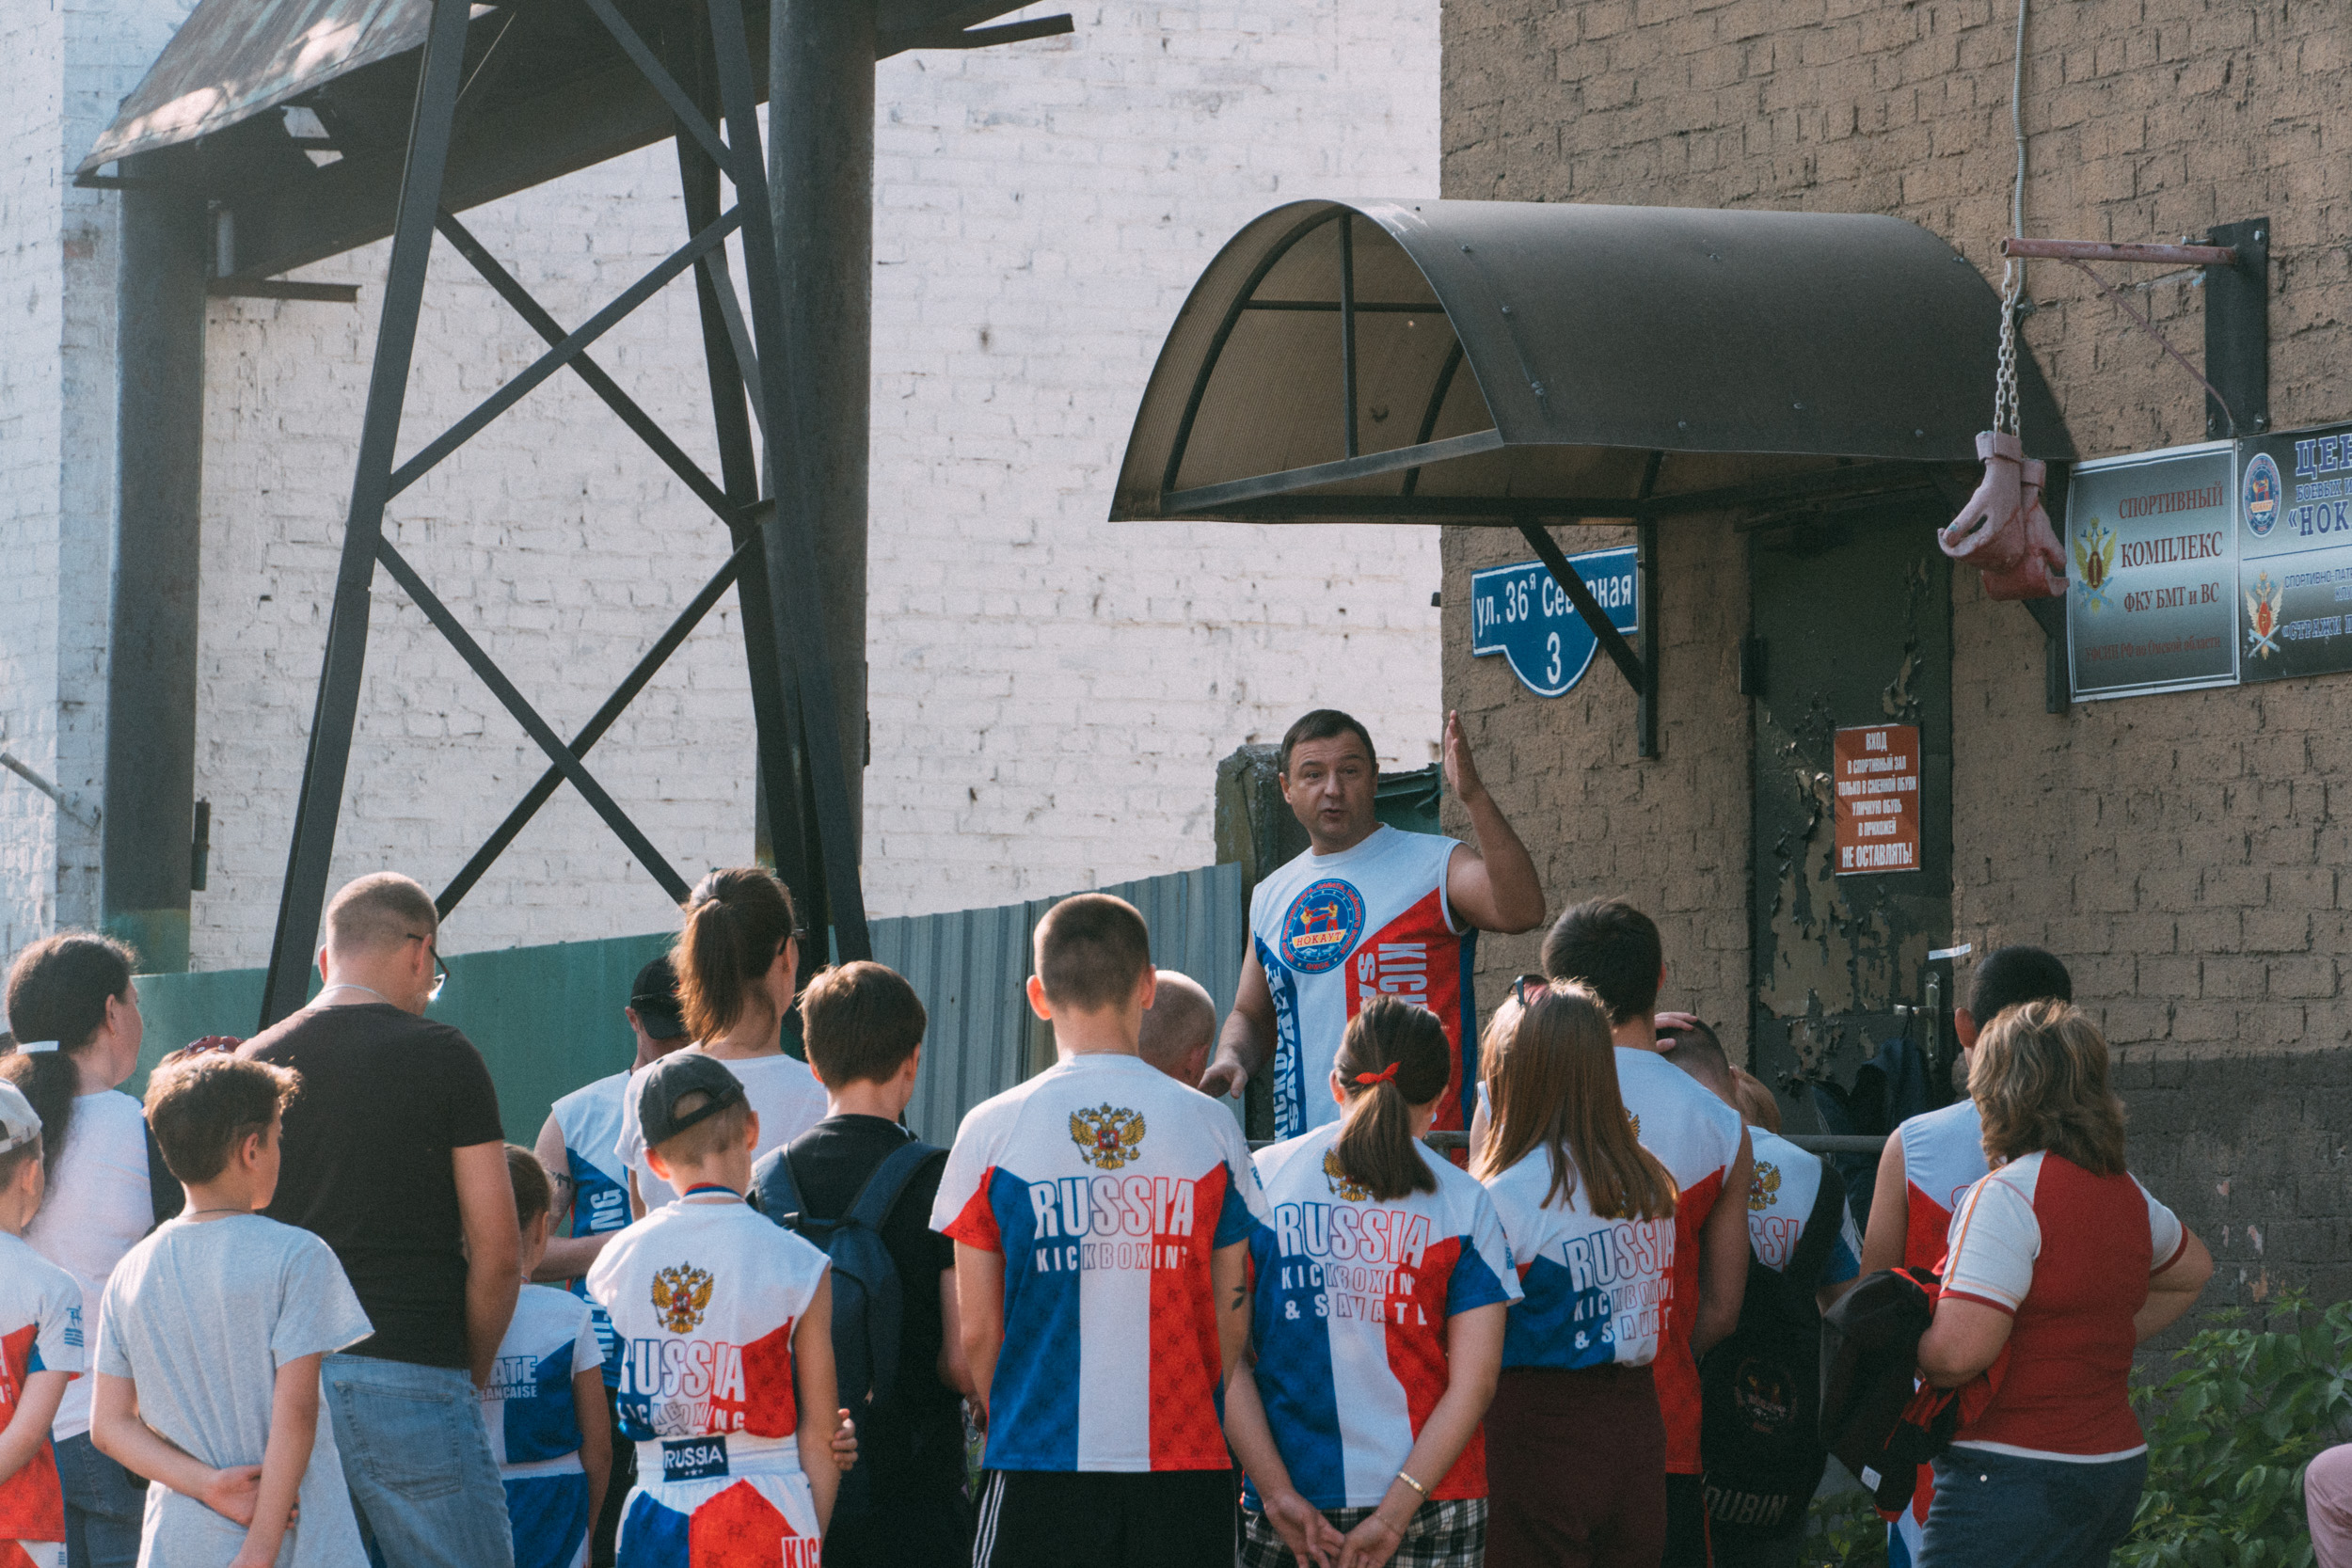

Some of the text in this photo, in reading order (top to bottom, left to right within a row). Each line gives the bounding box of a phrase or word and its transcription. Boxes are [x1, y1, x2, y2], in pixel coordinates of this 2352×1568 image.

[2119, 481, 2224, 519] СПОРТИВНЫЙ
[2296, 478, 2342, 502] БОЕВЫХ
[2121, 531, 2223, 568] КОМПЛЕКС
[1476, 595, 1501, 638] ул.
[1542, 575, 1632, 618] Севрная
[2123, 581, 2219, 613] ФКУ БМТ и ВС
[2281, 615, 2342, 641] «СТРАЖИ
[1546, 631, 1562, 685] 3
[1866, 731, 1887, 752] ВХОД
[1847, 753, 1906, 774] В СПОРТИВНЫЙ ЗАЛ
[1838, 775, 1916, 797] ТОЛЬКО В СМЕННОЙ ОБУВИ
[1851, 799, 1902, 816] УЛИЧНУЮ ОБУВЬ
[1858, 822, 1864, 837] В
[1842, 842, 1913, 868] НЕ ОСТАВЛЯТЬ!
[1296, 931, 1342, 947] НОКАУТ
[1028, 1175, 1195, 1240] RUSSIA
[1275, 1201, 1430, 1269] RUSSIA
[1563, 1216, 1676, 1292] RUSSIA
[1285, 1300, 1300, 1321] &
[1575, 1330, 1590, 1350] &
[621, 1338, 746, 1402] RUSSIA
[664, 1445, 723, 1469] RUSSIA
